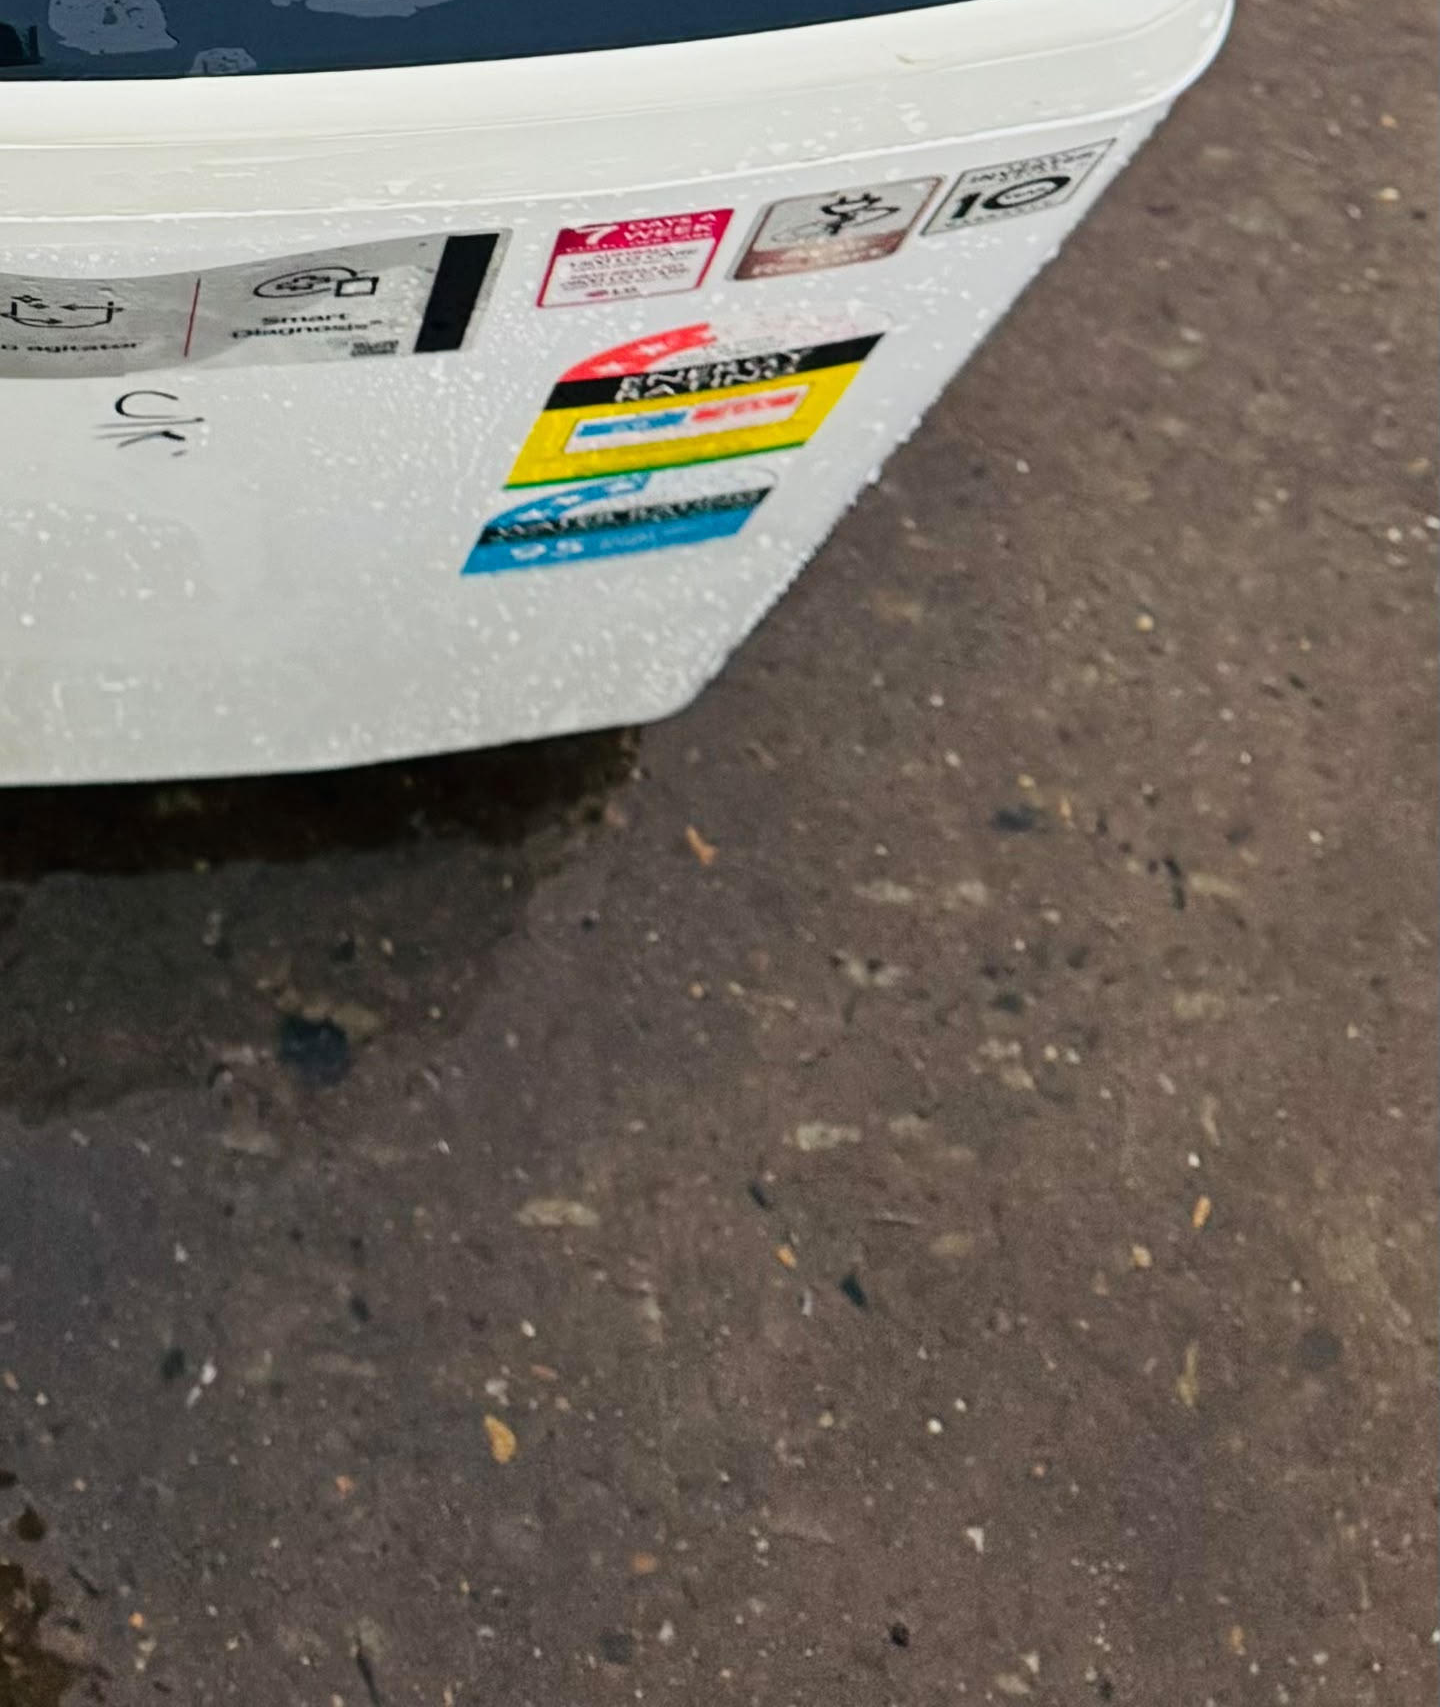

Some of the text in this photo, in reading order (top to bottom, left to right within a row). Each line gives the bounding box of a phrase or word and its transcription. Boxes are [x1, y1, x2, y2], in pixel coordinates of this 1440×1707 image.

[573, 224, 620, 245] 7
[262, 311, 350, 326] Smart
[26, 340, 140, 354] agitator
